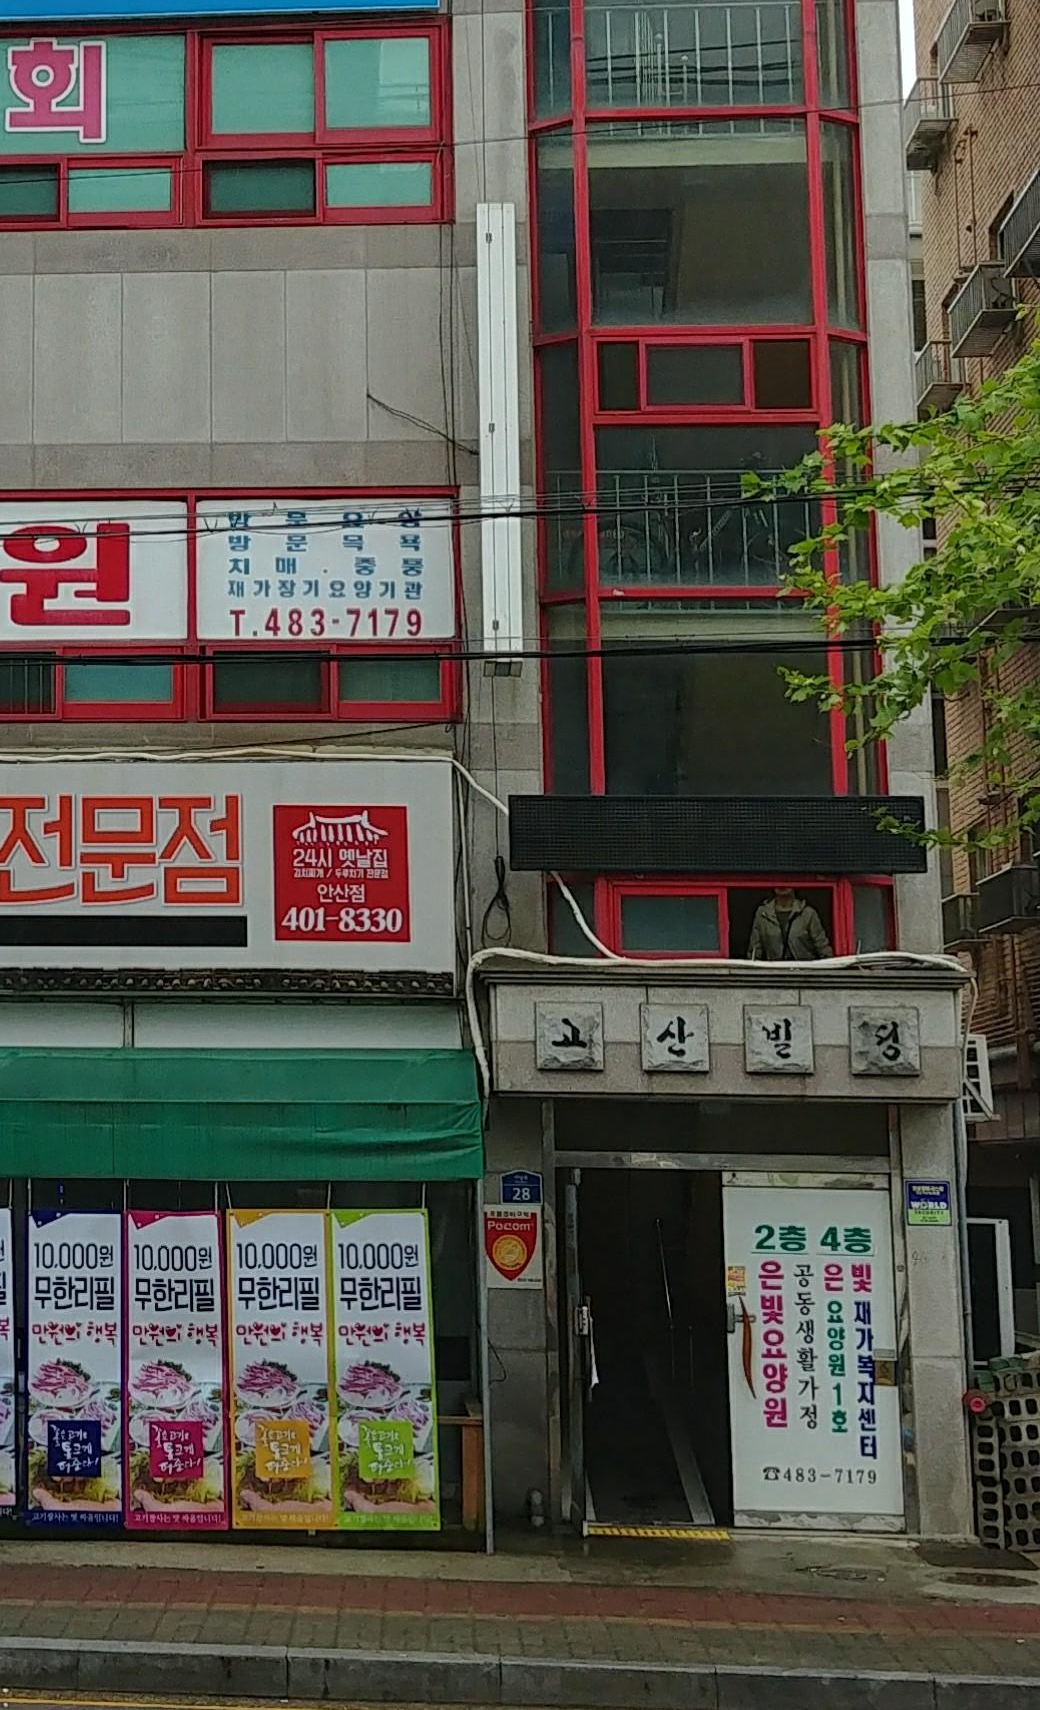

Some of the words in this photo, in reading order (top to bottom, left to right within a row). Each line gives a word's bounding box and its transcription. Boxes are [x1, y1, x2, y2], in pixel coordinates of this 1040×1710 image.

[229, 608, 423, 637] T.483-7179
[292, 848, 333, 868] 24시
[339, 848, 388, 869] 옛날집
[317, 883, 365, 903] 안산점
[281, 906, 403, 933] 401-8330
[512, 1187, 531, 1201] 28
[754, 1224, 807, 1252] 2층
[819, 1225, 872, 1253] 4층
[33, 1243, 114, 1269] 10,000원
[133, 1243, 213, 1272] 10,000원
[236, 1243, 318, 1270] 10,000원
[338, 1243, 419, 1270] 10,000원
[33, 1276, 115, 1311] 무한리필
[133, 1277, 215, 1312] 무한리필
[237, 1276, 320, 1311] 무한리필
[339, 1276, 422, 1311] 무한리필
[32, 1322, 82, 1346] 만원의
[86, 1321, 117, 1346] 행복
[132, 1322, 183, 1347] 만원의
[187, 1322, 218, 1347] 행복
[235, 1322, 287, 1346] 만원의
[291, 1321, 323, 1346] 행복
[337, 1322, 389, 1346] 만원의
[394, 1321, 426, 1346] 행복
[758, 1259, 788, 1428] 은빛요양원
[793, 1263, 819, 1431] 공동생활가정
[782, 1468, 878, 1485] 483-7179
